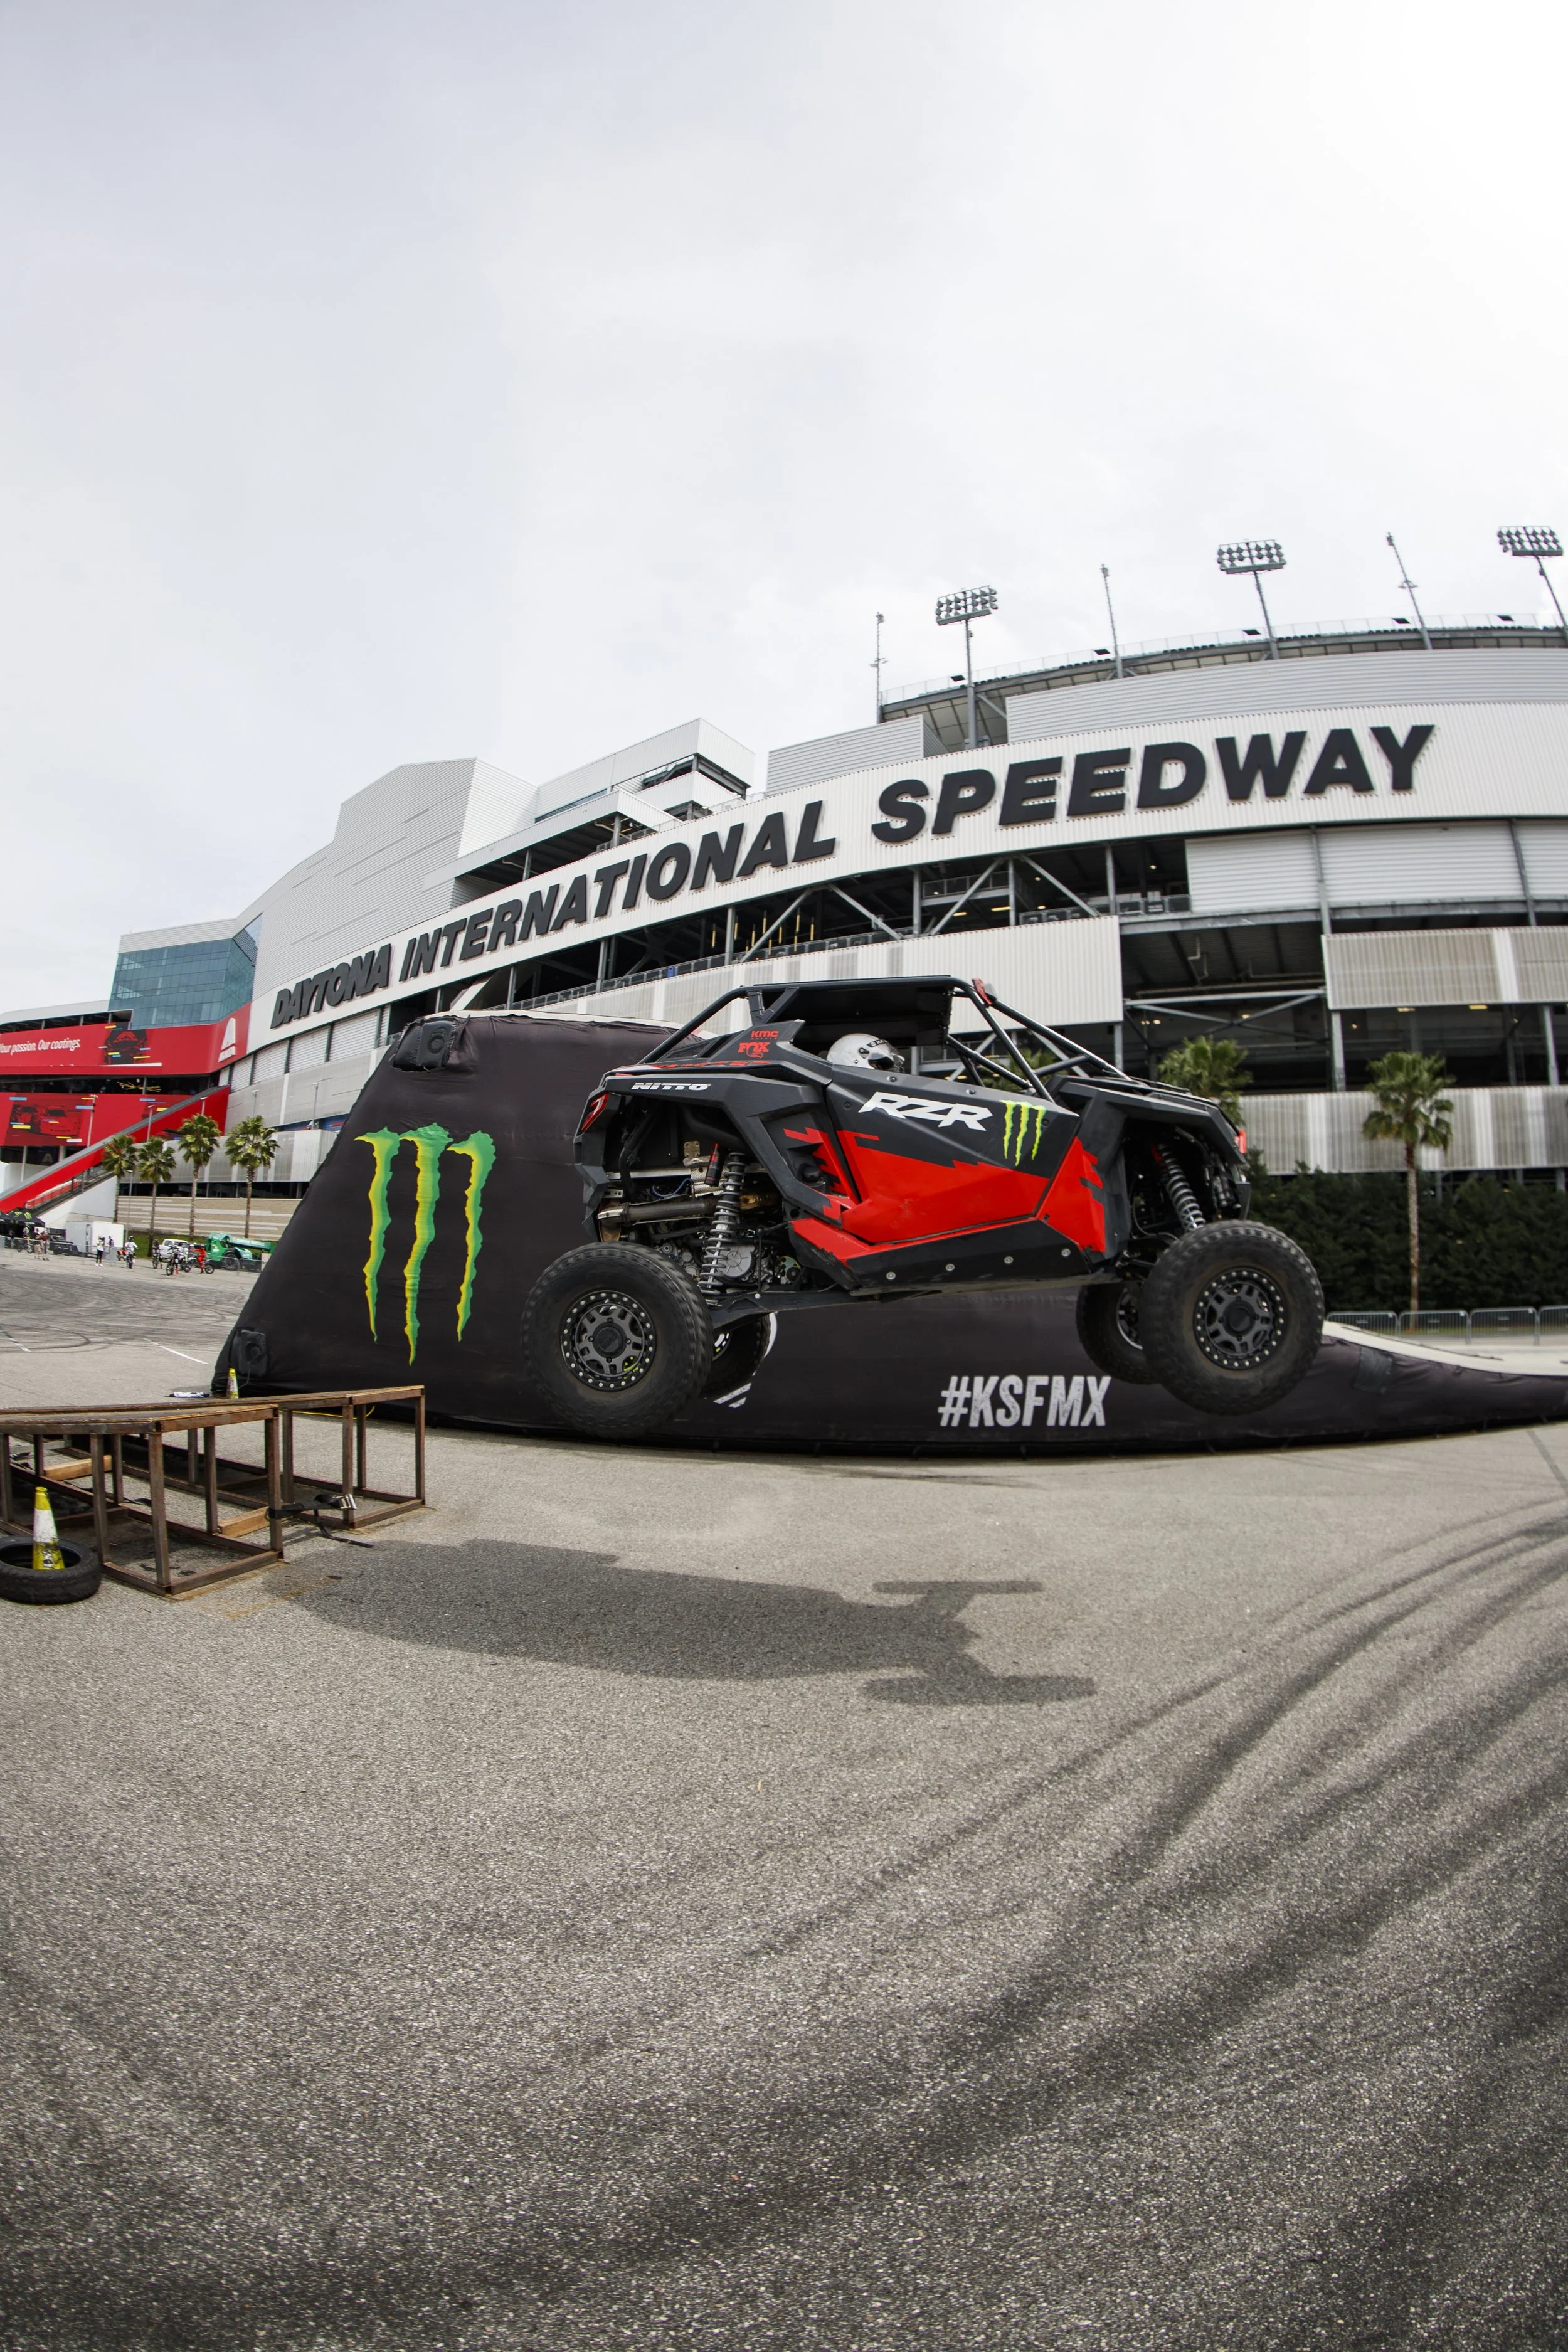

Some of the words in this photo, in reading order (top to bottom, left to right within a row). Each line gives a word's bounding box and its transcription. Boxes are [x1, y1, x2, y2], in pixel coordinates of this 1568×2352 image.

[270, 943, 392, 1029] DAYTONA
[399, 800, 836, 980] INTERNATIONAL
[871, 725, 1435, 844] SPEEDWAY
[10, 1041, 36, 1056] passion.
[38, 1039, 51, 1051] Our
[50, 1037, 80, 1051] coatings.
[737, 1042, 770, 1059] FOX
[631, 1083, 709, 1091] NITTO
[858, 1091, 993, 1131] RZR
[938, 1375, 1112, 1427] #KSFMX
